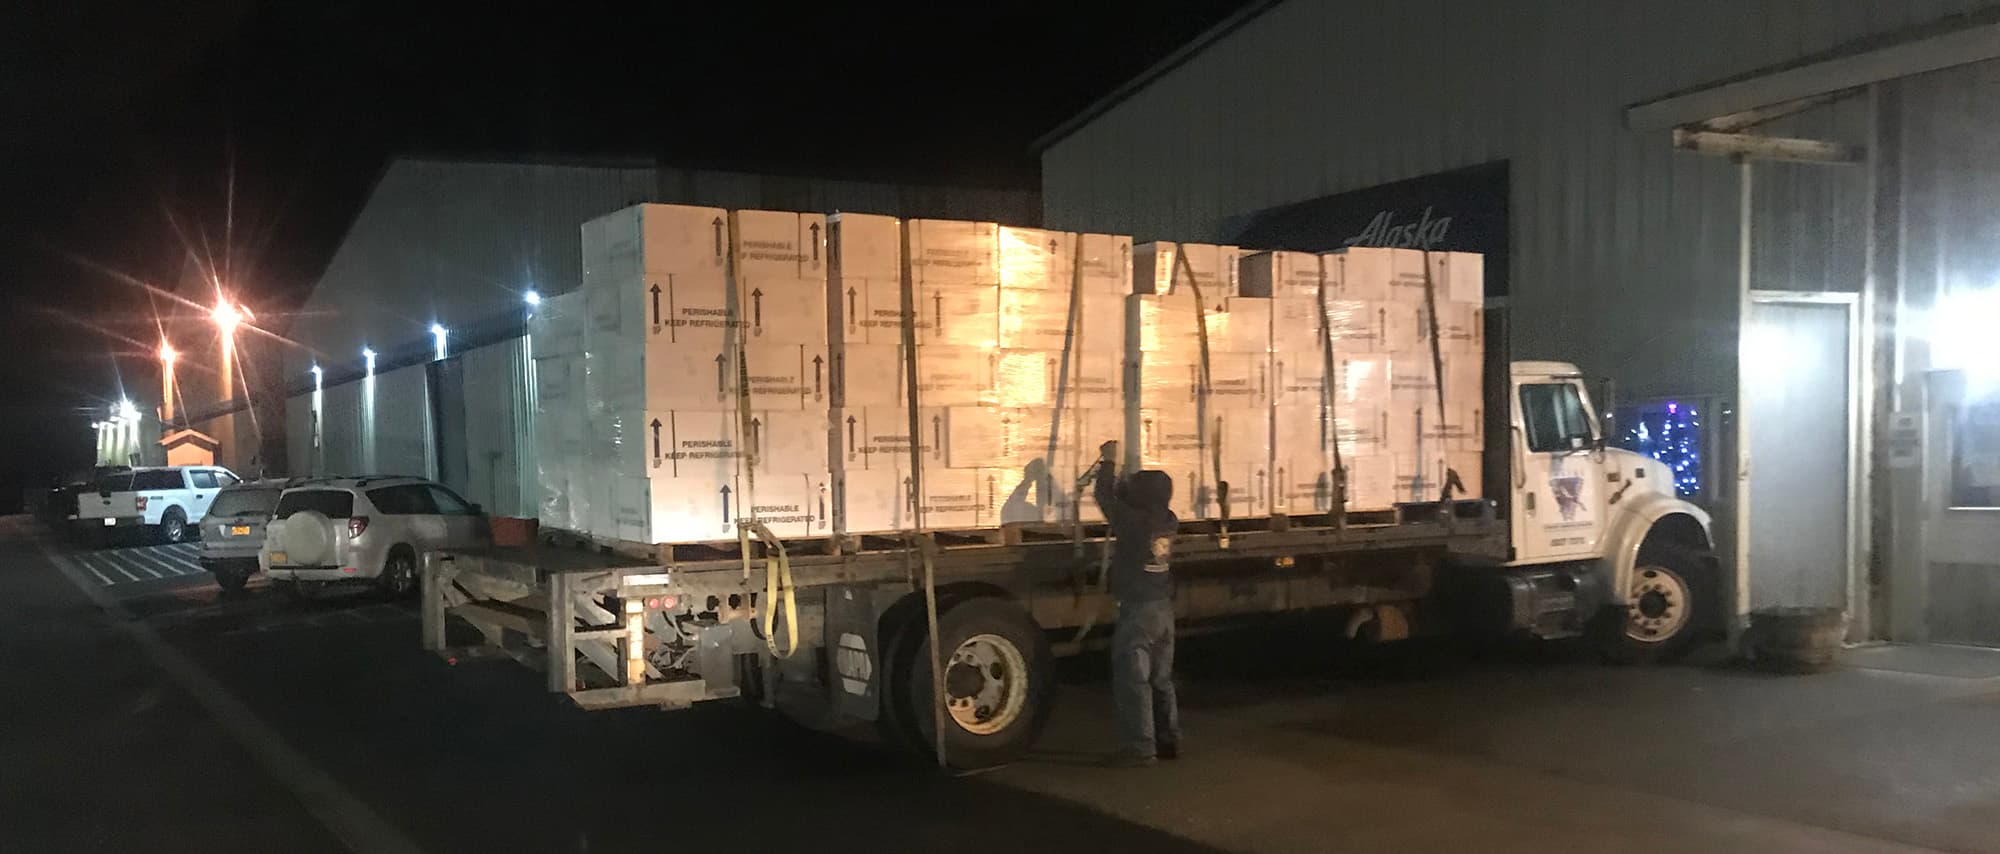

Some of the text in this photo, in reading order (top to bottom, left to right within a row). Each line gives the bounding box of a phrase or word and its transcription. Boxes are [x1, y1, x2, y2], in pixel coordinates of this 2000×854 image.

[1343, 206, 1452, 251] Alaska
[664, 319, 687, 327] KEEP
[682, 440, 733, 448] PERISHABLE
[664, 451, 750, 460] KEEP REFRIGERATE
[751, 505, 800, 513] PERISHABLE
[757, 515, 815, 525] REFRIGERATED
